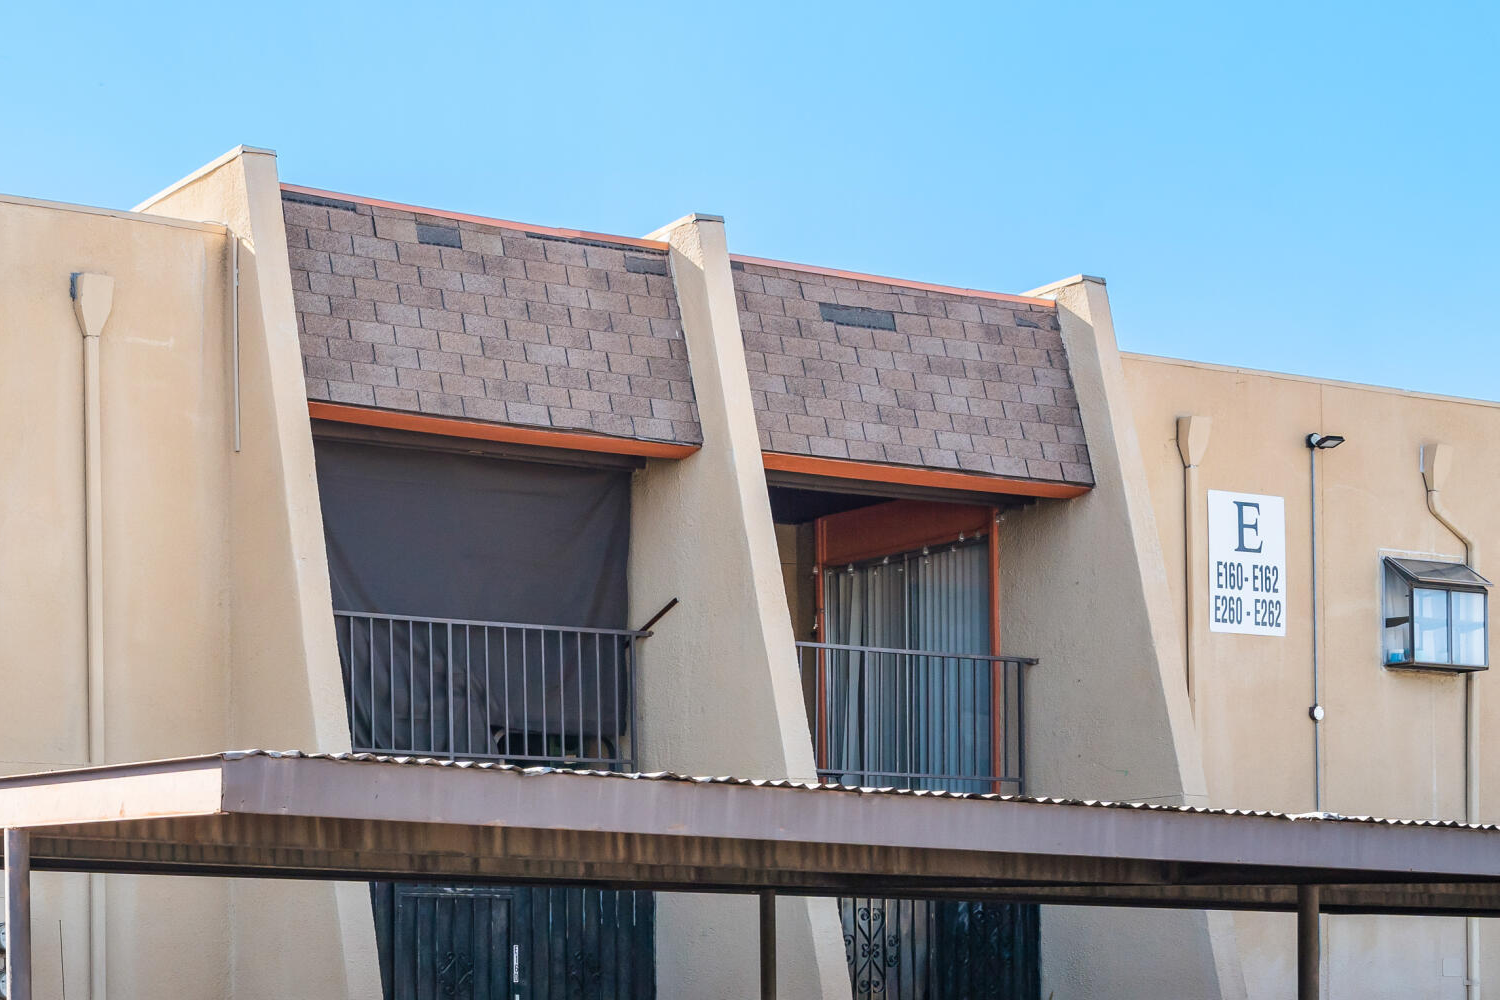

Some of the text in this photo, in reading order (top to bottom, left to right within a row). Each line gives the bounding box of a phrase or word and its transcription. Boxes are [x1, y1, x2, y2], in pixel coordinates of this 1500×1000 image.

[1232, 500, 1263, 554] E
[1252, 564, 1279, 594] E162
[1214, 594, 1243, 625] E260
[1254, 598, 1282, 628] E262
